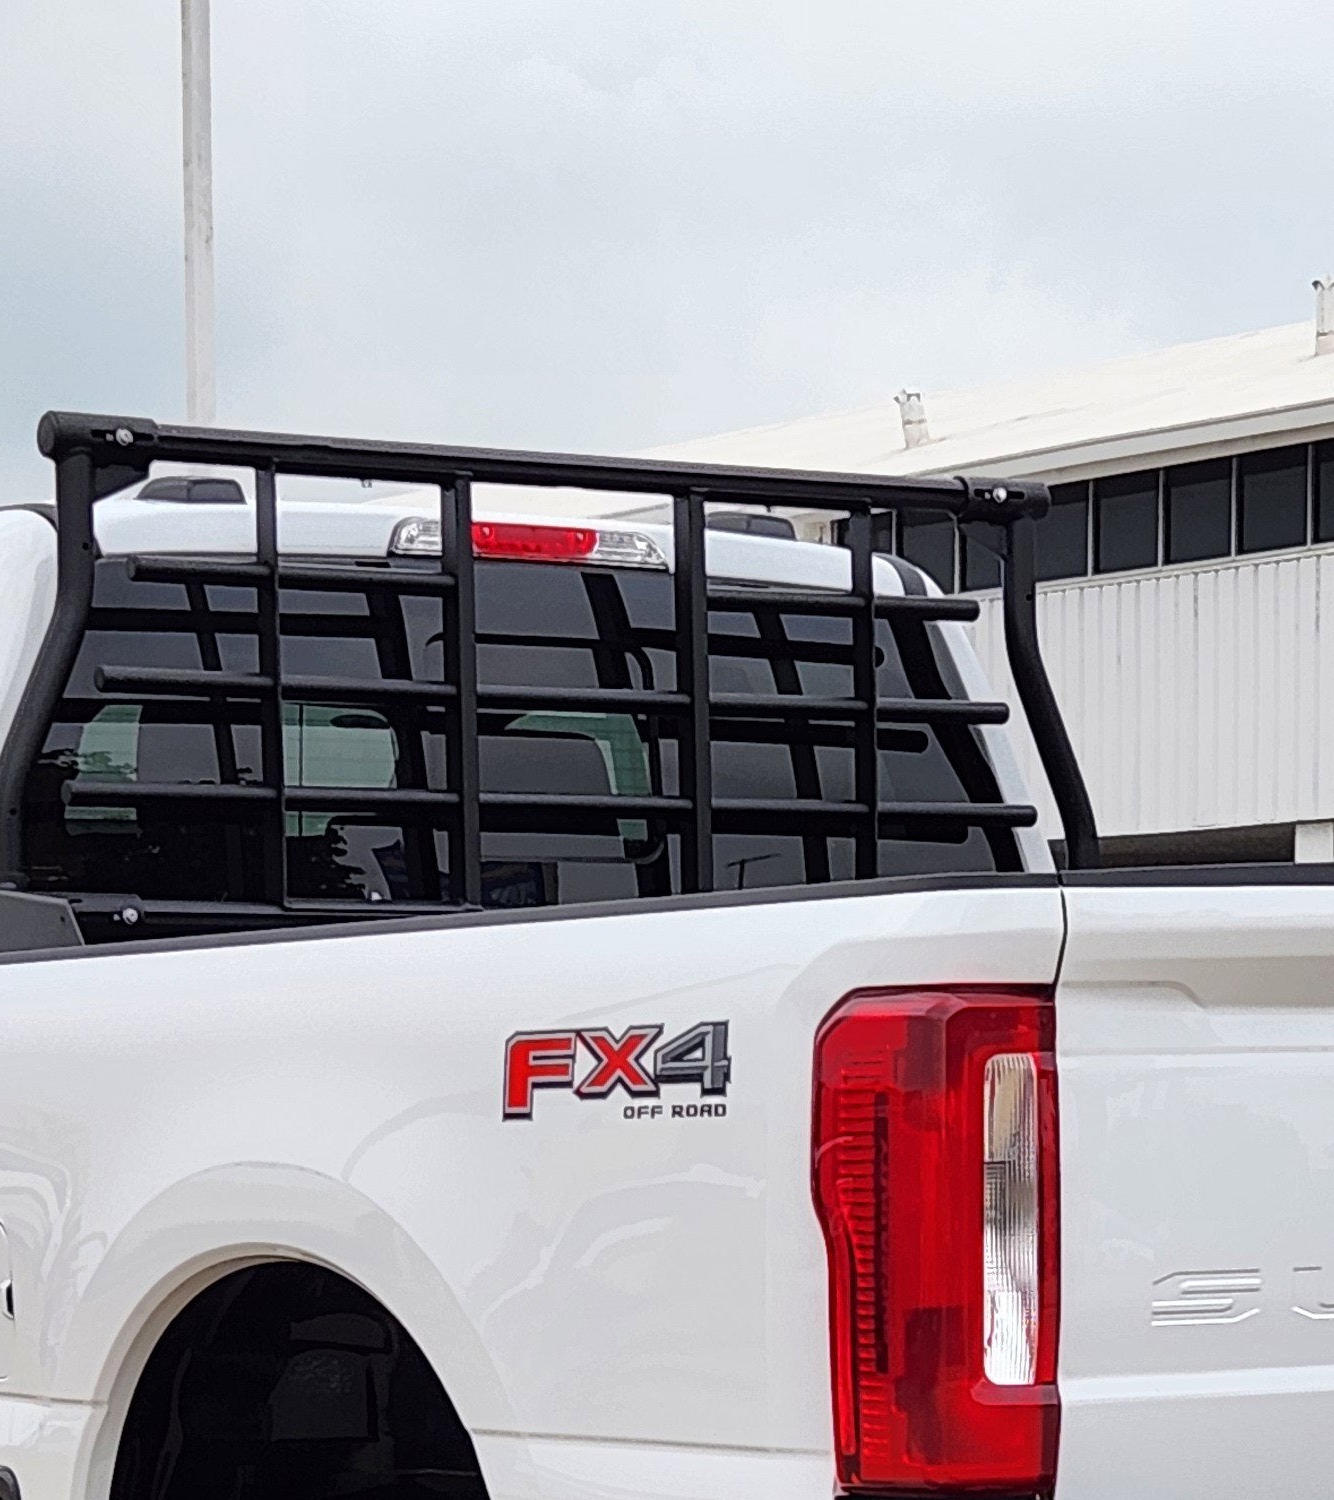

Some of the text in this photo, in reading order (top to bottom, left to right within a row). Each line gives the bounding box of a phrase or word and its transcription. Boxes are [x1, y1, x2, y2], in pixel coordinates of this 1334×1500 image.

[502, 1019, 731, 1122] FX4
[623, 1103, 728, 1120] OFF ROAD
